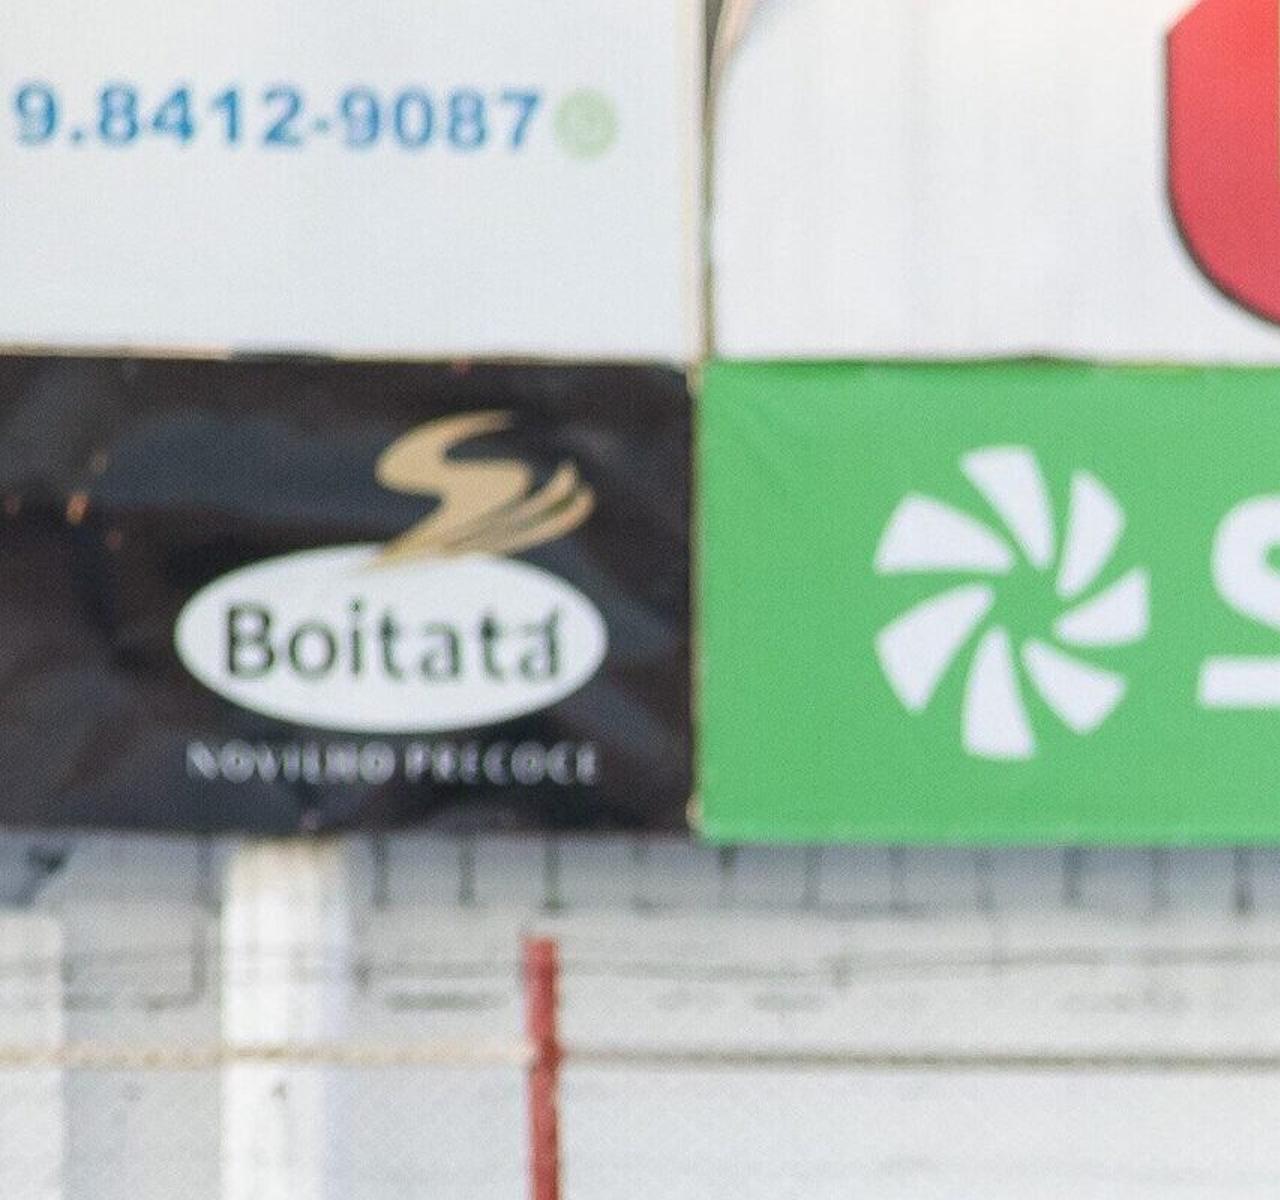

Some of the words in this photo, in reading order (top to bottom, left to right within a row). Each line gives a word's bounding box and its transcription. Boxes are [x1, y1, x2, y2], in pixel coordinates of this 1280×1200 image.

[15, 80, 540, 148] 9.8412-9087
[227, 597, 561, 683] Boitatá
[186, 740, 396, 785] NOVILHO
[404, 740, 597, 786] PRECOCE
